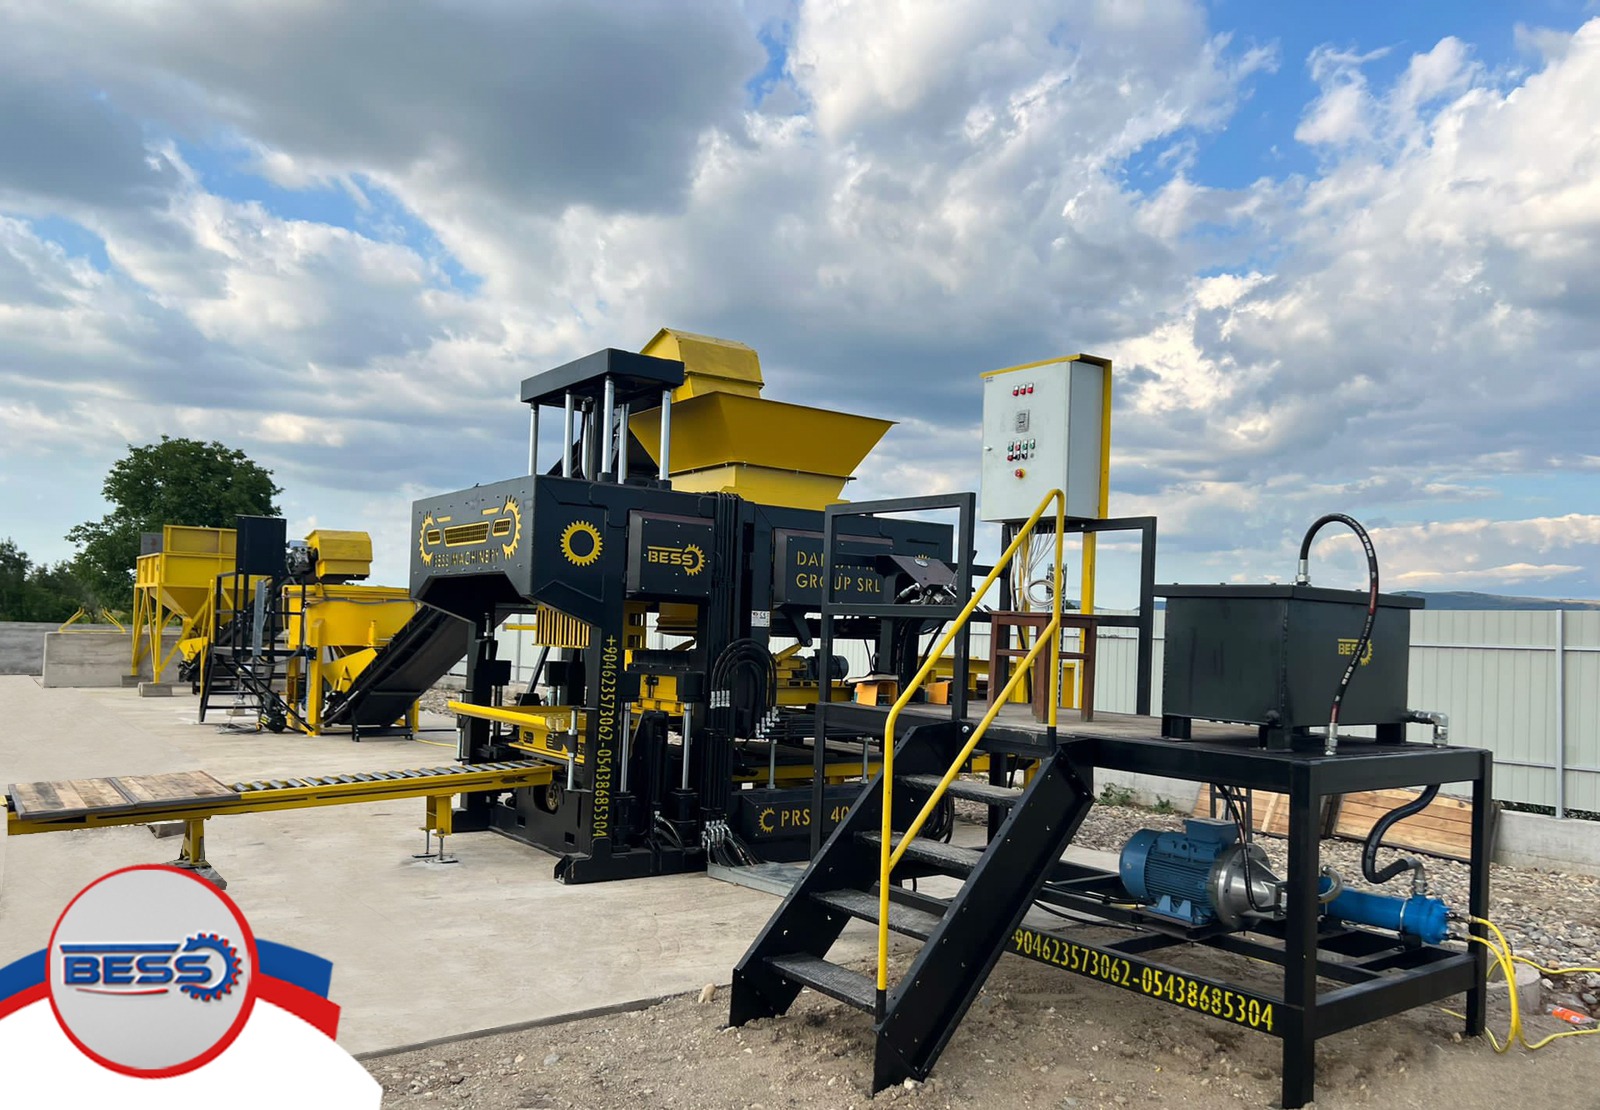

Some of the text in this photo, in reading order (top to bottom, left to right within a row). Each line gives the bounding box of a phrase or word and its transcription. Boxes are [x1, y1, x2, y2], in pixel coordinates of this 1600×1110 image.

[451, 548, 499, 566] MACHINERY
[648, 550, 694, 566] BESS
[796, 573, 880, 592] GRUP SRL
[1338, 643, 1366, 655] BES
[780, 808, 812, 827] PRS
[1011, 929, 1274, 1032] 904623573062-05438685304
